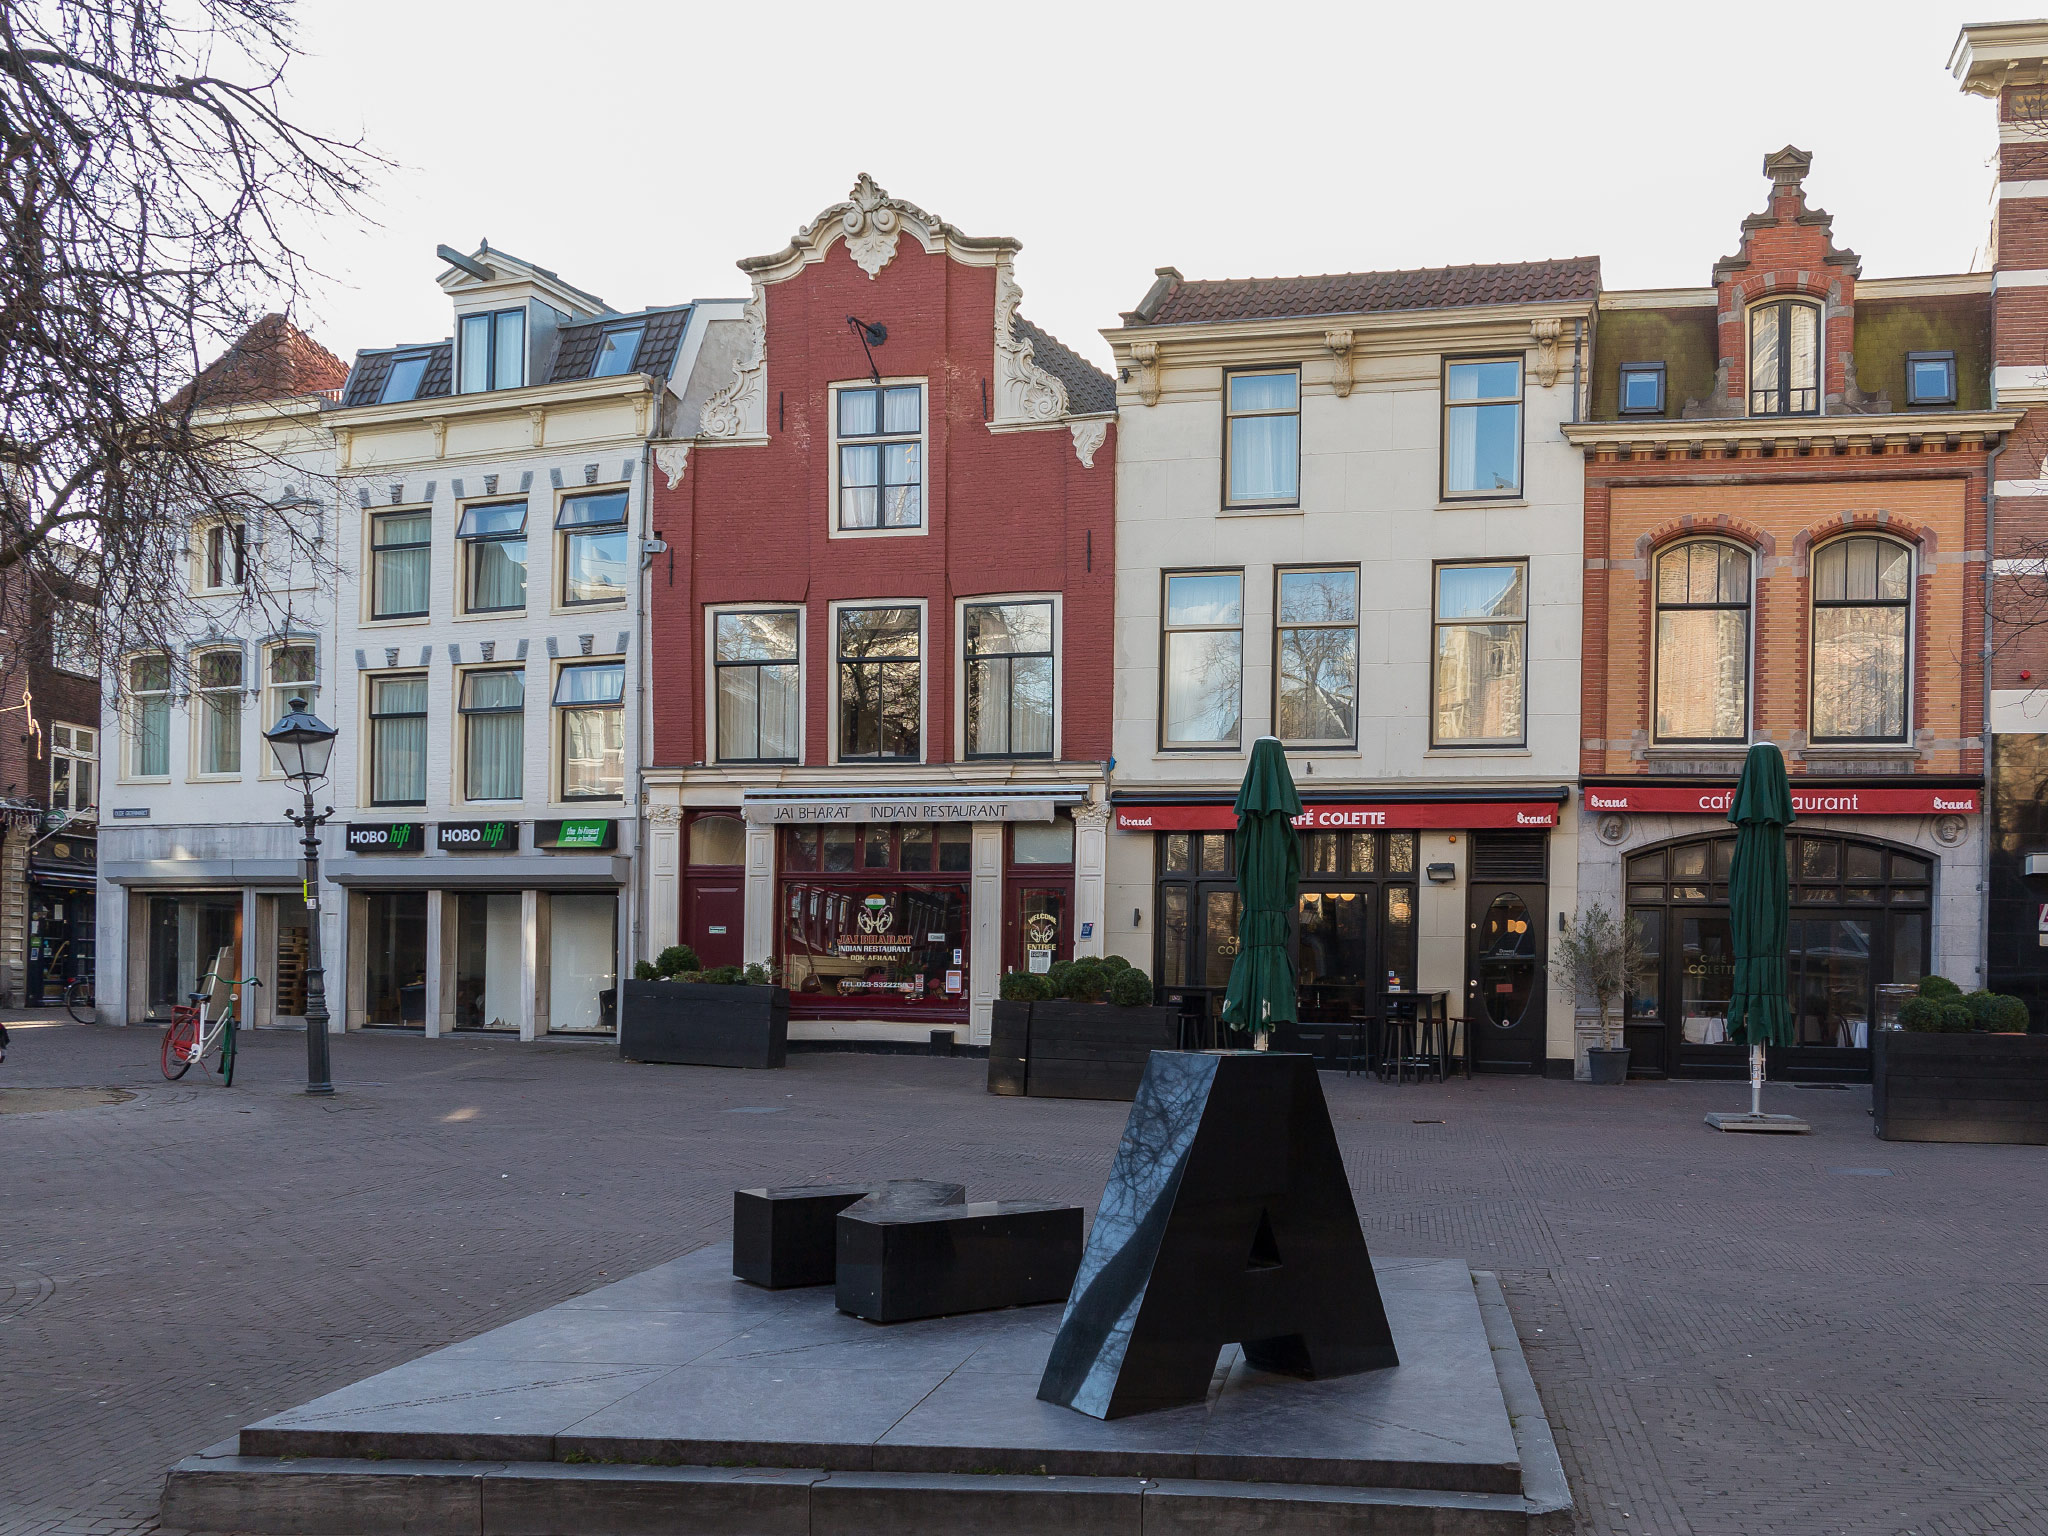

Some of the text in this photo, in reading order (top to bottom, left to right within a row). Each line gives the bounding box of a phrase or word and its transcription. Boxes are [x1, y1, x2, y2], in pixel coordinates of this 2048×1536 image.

[1591, 794, 1628, 808] Brand
[1699, 791, 1735, 809] caf
[1933, 796, 1973, 810] Brand
[774, 804, 1008, 819] JAI BHARAT INDIAN RESTAURANT
[1289, 808, 1386, 826] AFÉ COLETTE
[1516, 811, 1552, 824] Brand
[1119, 814, 1152, 827] Brand
[350, 823, 411, 848] HOBO hifi
[441, 822, 505, 848] HOBO hifi
[1028, 913, 1057, 925] WELCOME
[837, 934, 913, 945] JAI BHARAT
[864, 945, 911, 953] RESTAURANT
[1027, 943, 1057, 951] ENTREE
